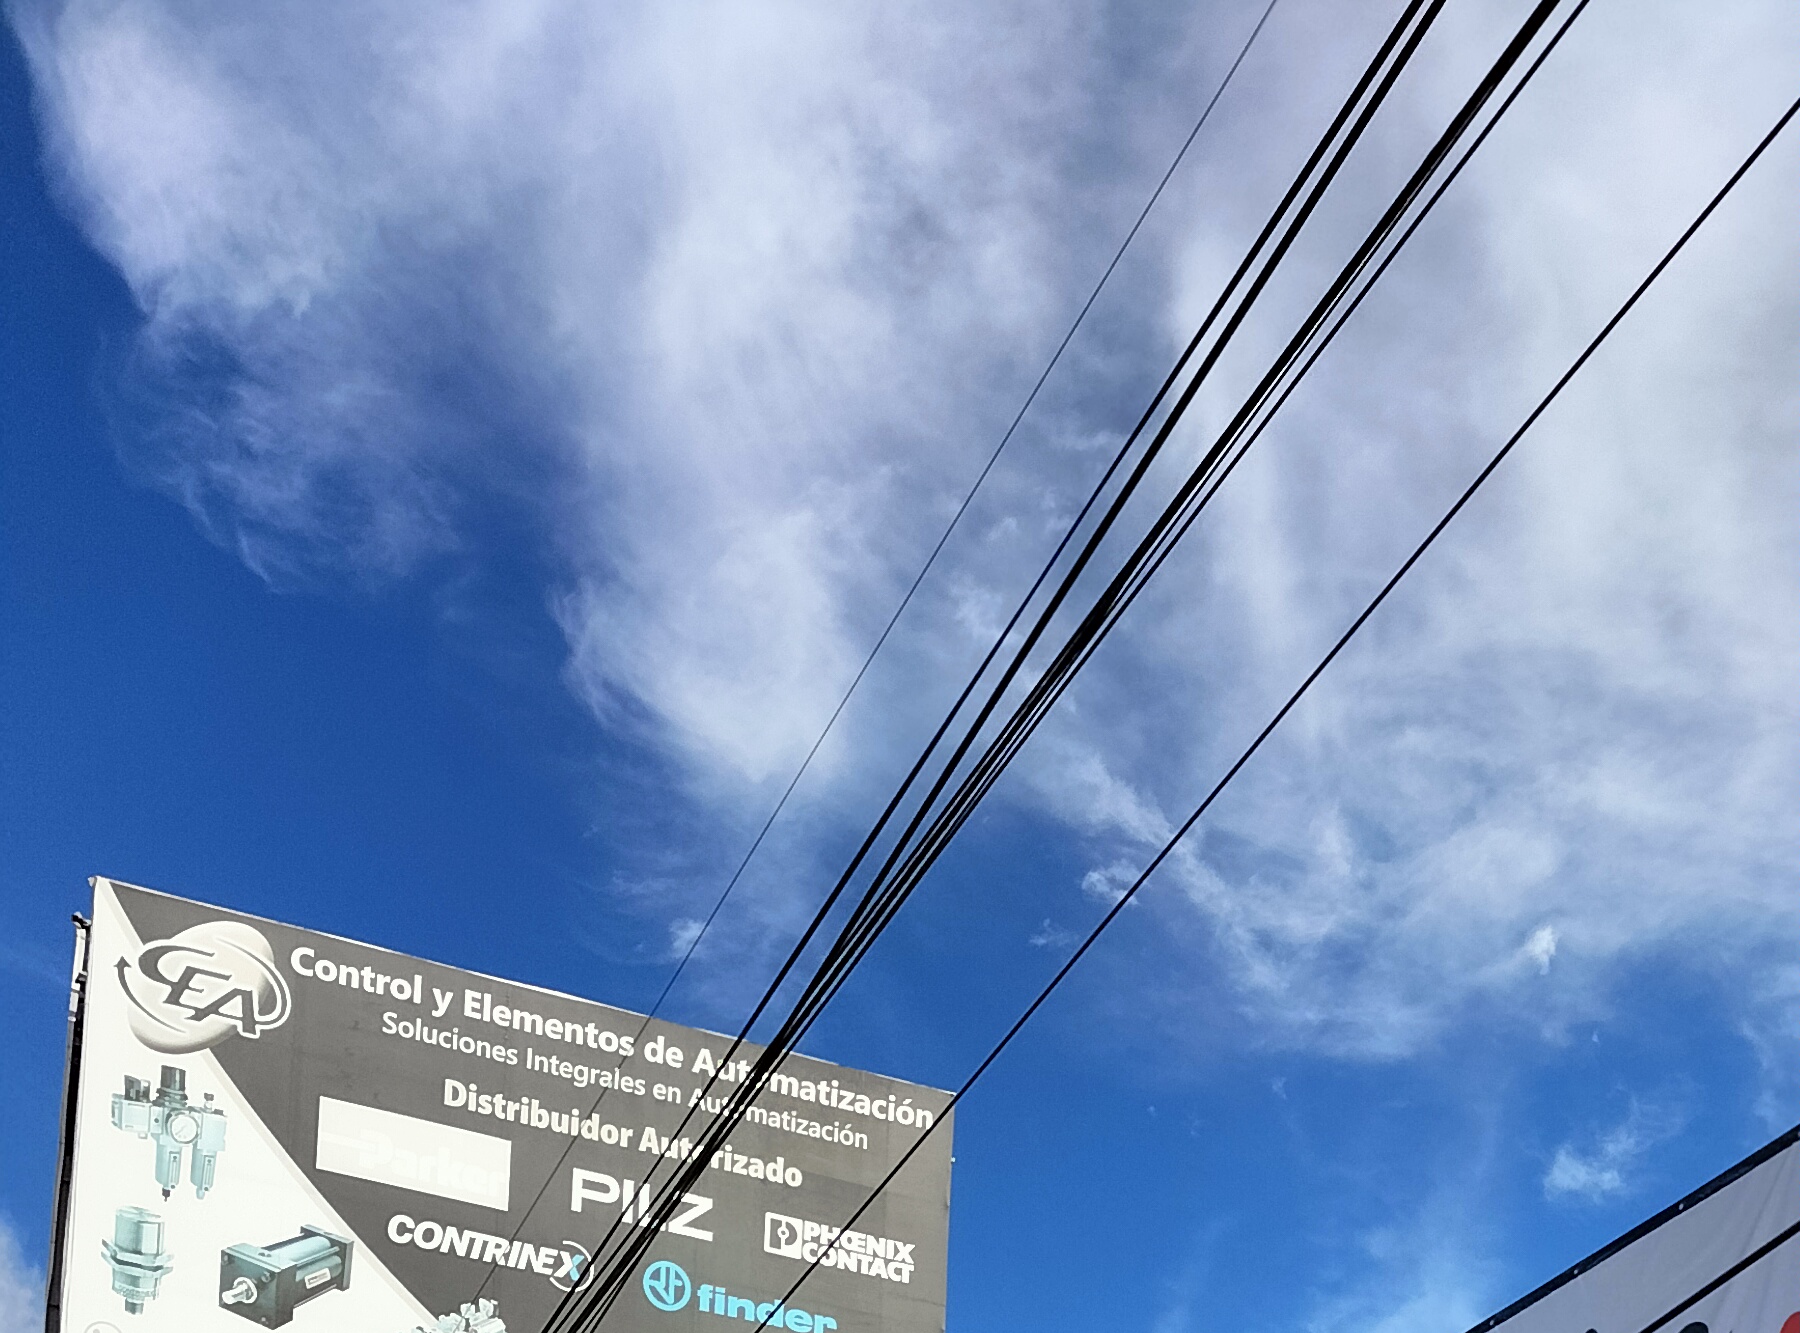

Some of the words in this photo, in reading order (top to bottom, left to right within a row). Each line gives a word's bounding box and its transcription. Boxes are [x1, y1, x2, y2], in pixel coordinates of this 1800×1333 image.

[137, 943, 260, 1038] CEA
[290, 947, 422, 1004] Control
[432, 987, 453, 1018] y
[463, 989, 635, 1057] Elementos
[643, 1035, 684, 1068] de
[691, 1047, 934, 1130] Autmatización
[382, 1011, 518, 1065] Soluciones
[526, 1048, 646, 1096] Integrales
[652, 1084, 681, 1104] en
[687, 1087, 868, 1150] Autmatización
[443, 1078, 634, 1148] Distribuidor
[570, 1167, 713, 1242] PILZ
[387, 1214, 585, 1281] CONTRINEX
[802, 1241, 915, 1284] CONTACT
